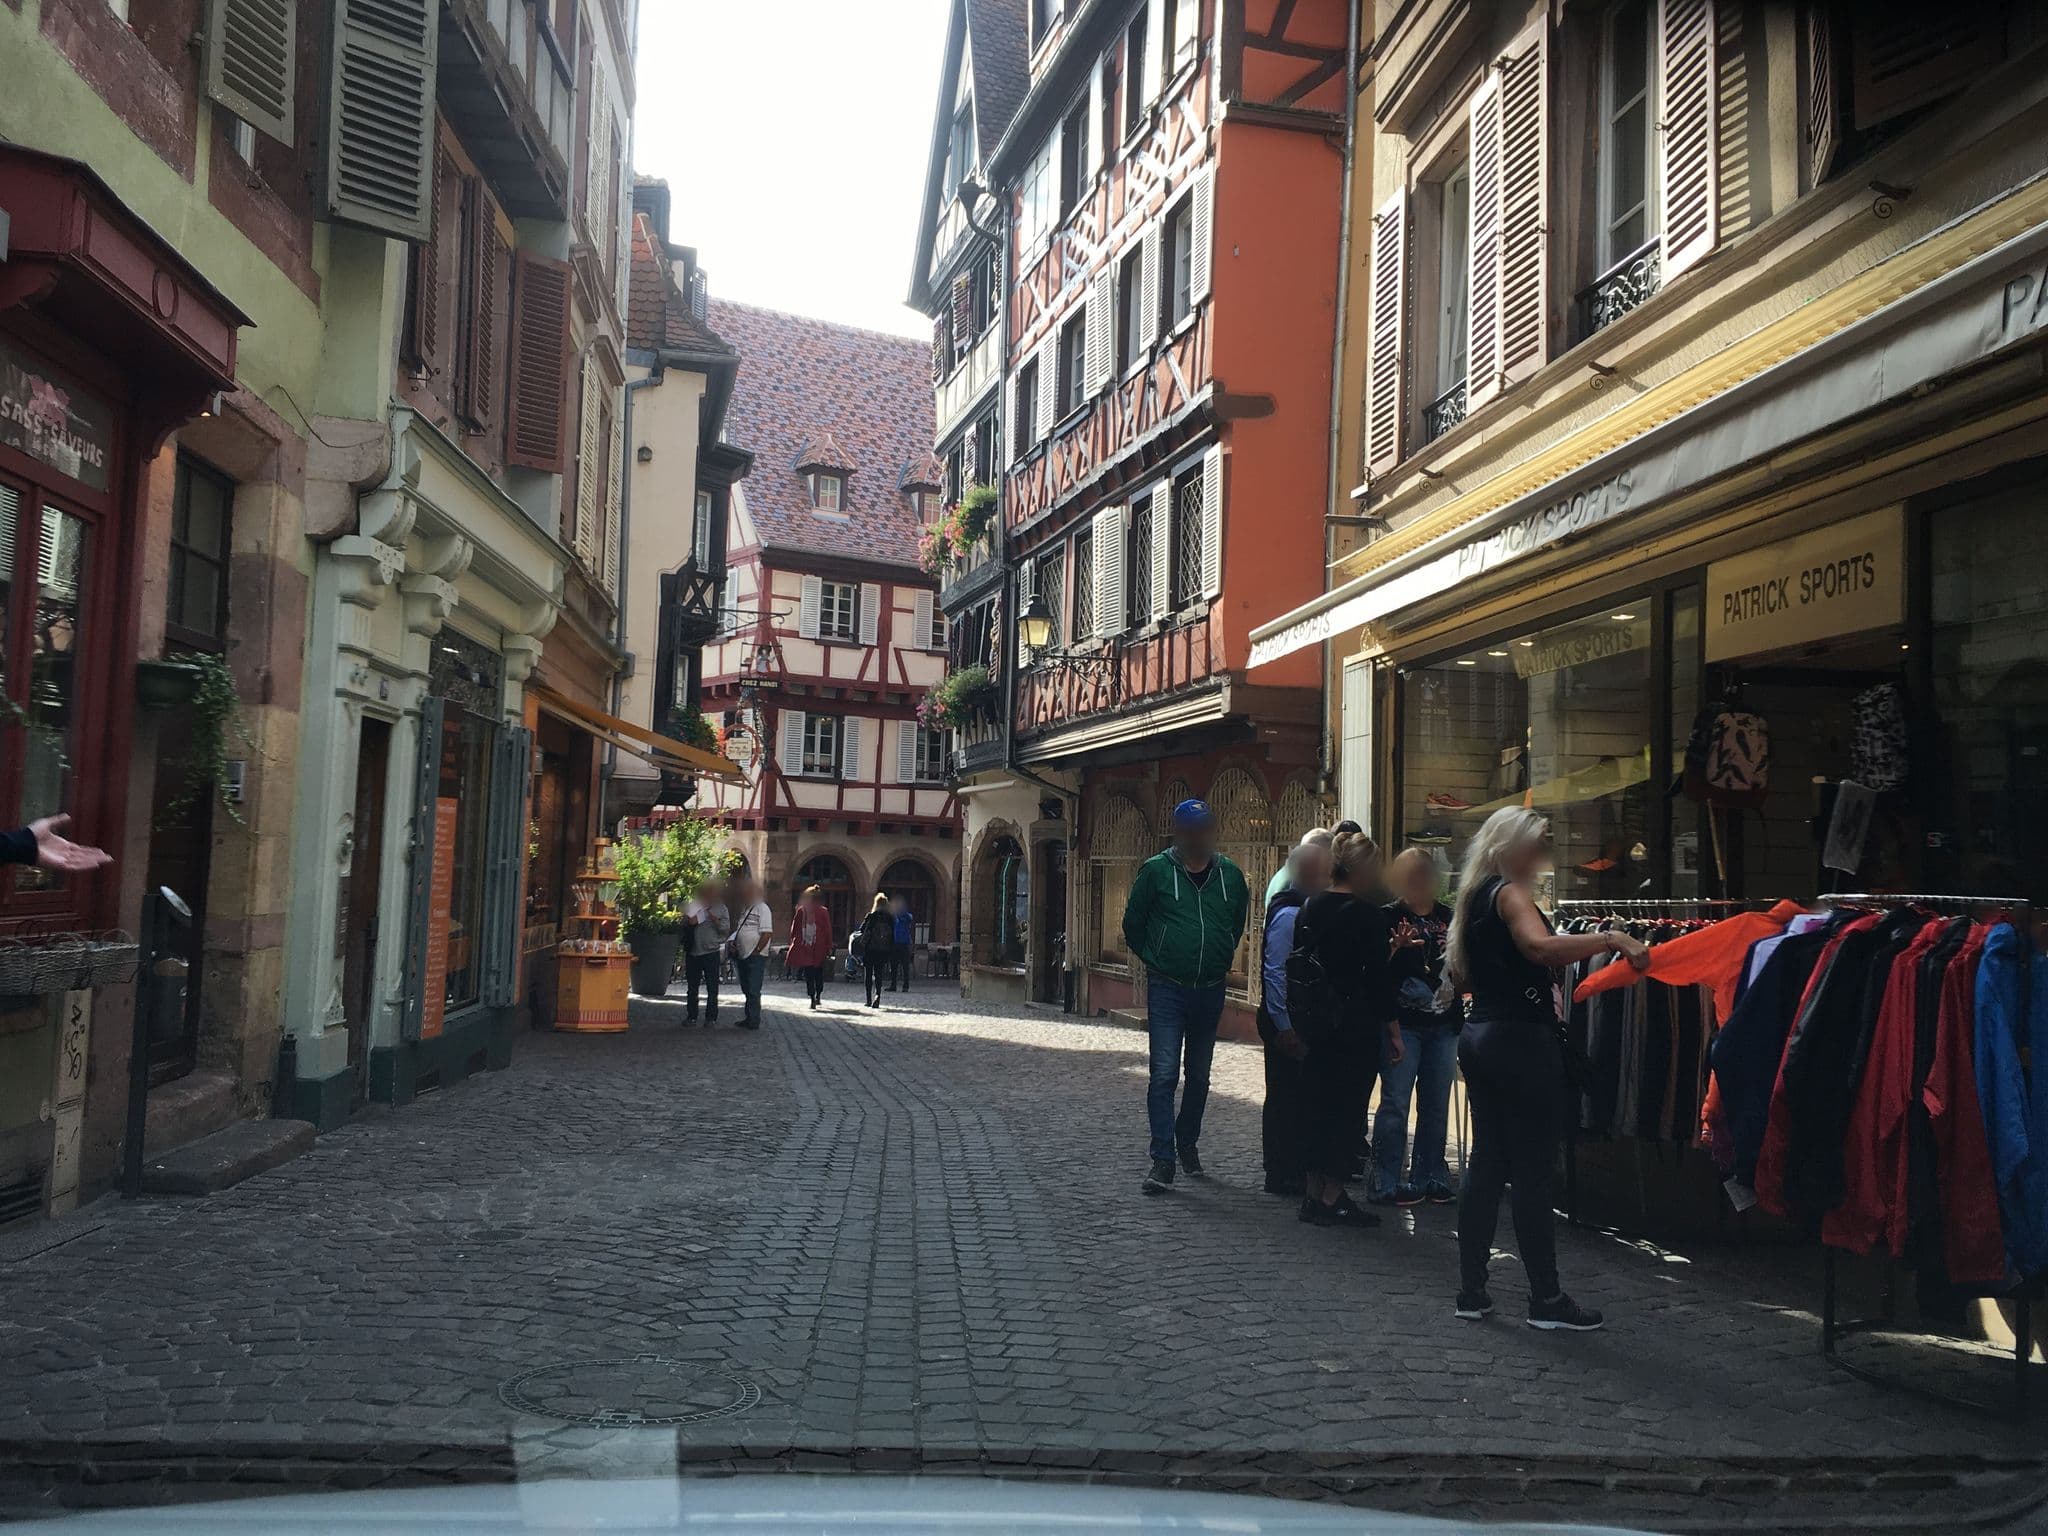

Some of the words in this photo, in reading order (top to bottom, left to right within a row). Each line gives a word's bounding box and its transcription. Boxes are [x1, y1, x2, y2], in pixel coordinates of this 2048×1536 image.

[1723, 576, 1791, 625] PATRICK
[1800, 552, 1875, 605] SPORTS
[1518, 641, 1572, 677] PATRICK
[1574, 625, 1633, 662] SPORTS
